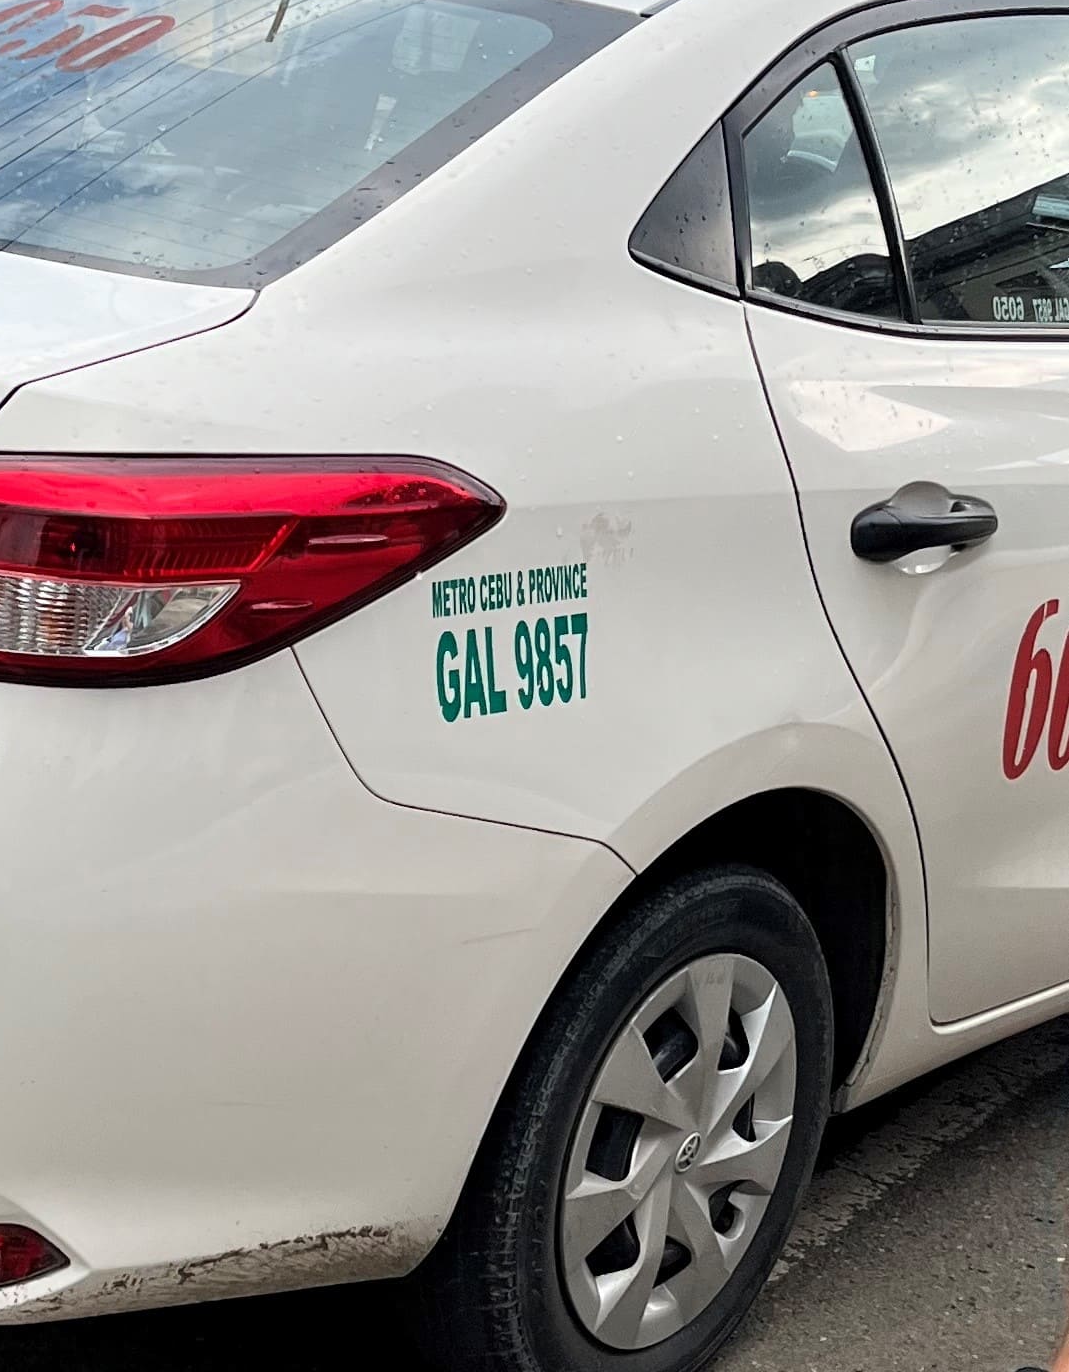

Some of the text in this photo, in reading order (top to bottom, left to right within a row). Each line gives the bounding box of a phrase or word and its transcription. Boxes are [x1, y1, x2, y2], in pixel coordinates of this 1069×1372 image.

[432, 563, 587, 618] METRO CEBU & PROVINCE
[436, 613, 588, 722] GAL 9857
